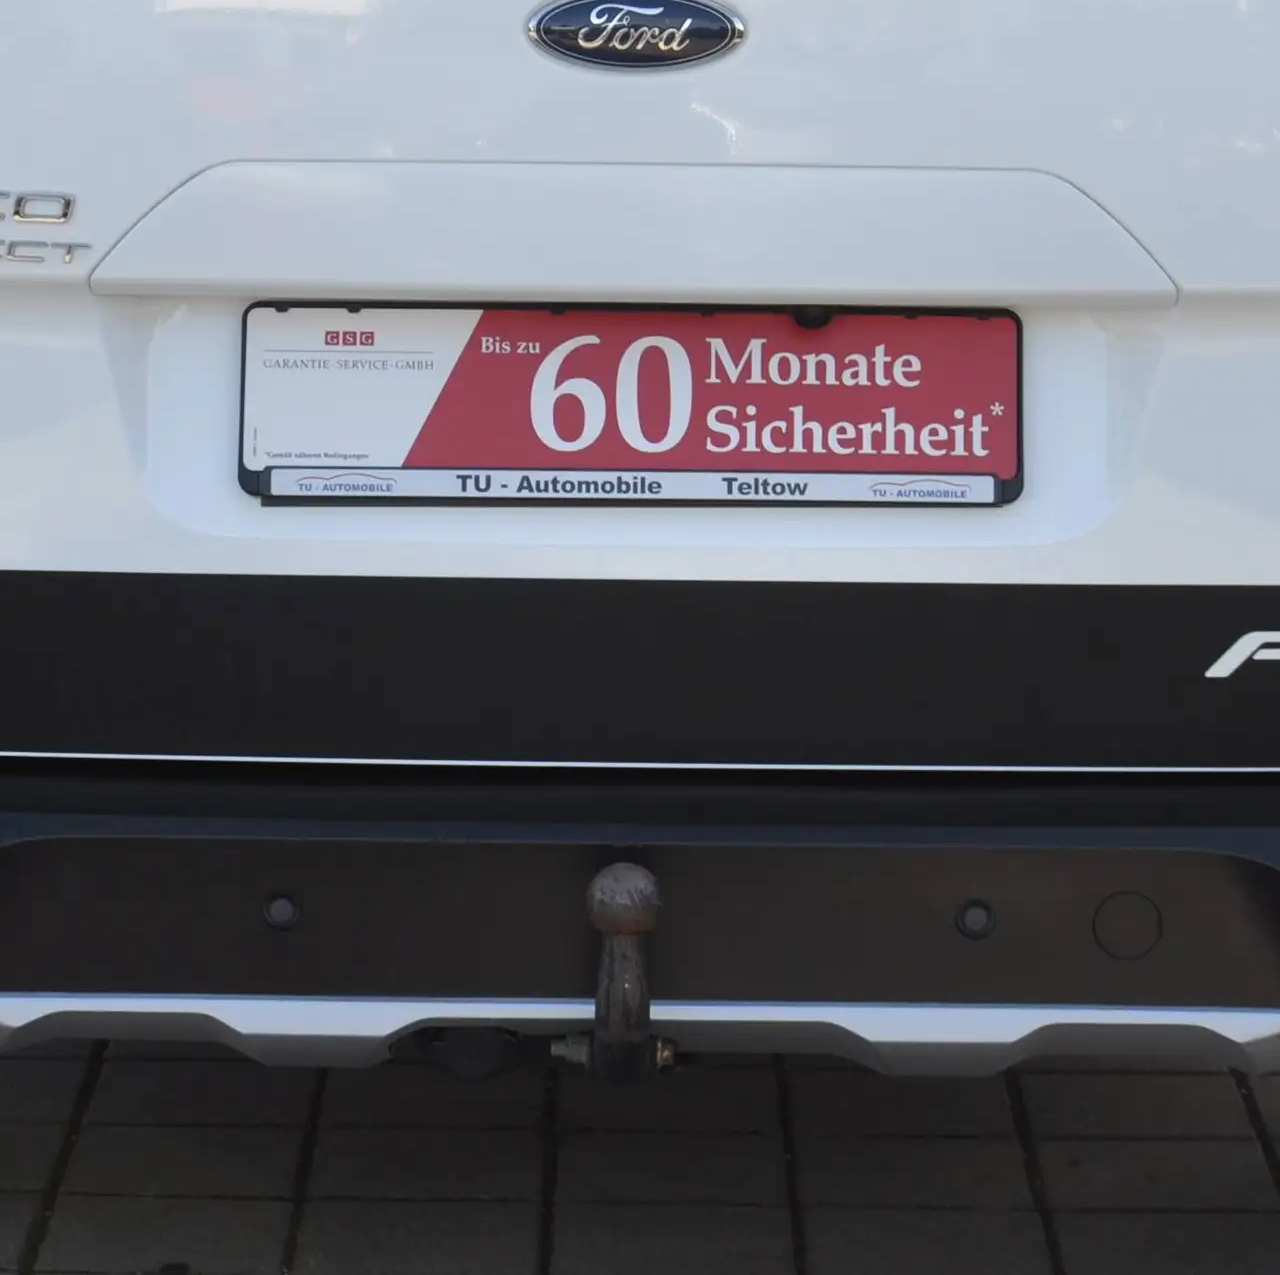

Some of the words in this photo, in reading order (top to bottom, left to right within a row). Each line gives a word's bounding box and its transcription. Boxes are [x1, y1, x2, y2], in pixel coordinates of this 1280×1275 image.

[577, 2, 694, 52] Ford
[325, 331, 375, 346] GSG
[481, 336, 511, 354] Bis
[516, 341, 541, 354] zu
[705, 337, 922, 387] Monate
[530, 334, 693, 453] 60
[298, 483, 312, 492] TU
[322, 483, 393, 492] AUTOMOBILE
[456, 474, 492, 493] TU
[516, 475, 662, 495] Automobile
[721, 476, 808, 496] Teltow
[872, 489, 887, 498] TU
[896, 489, 968, 499] AUTOMOBILE
